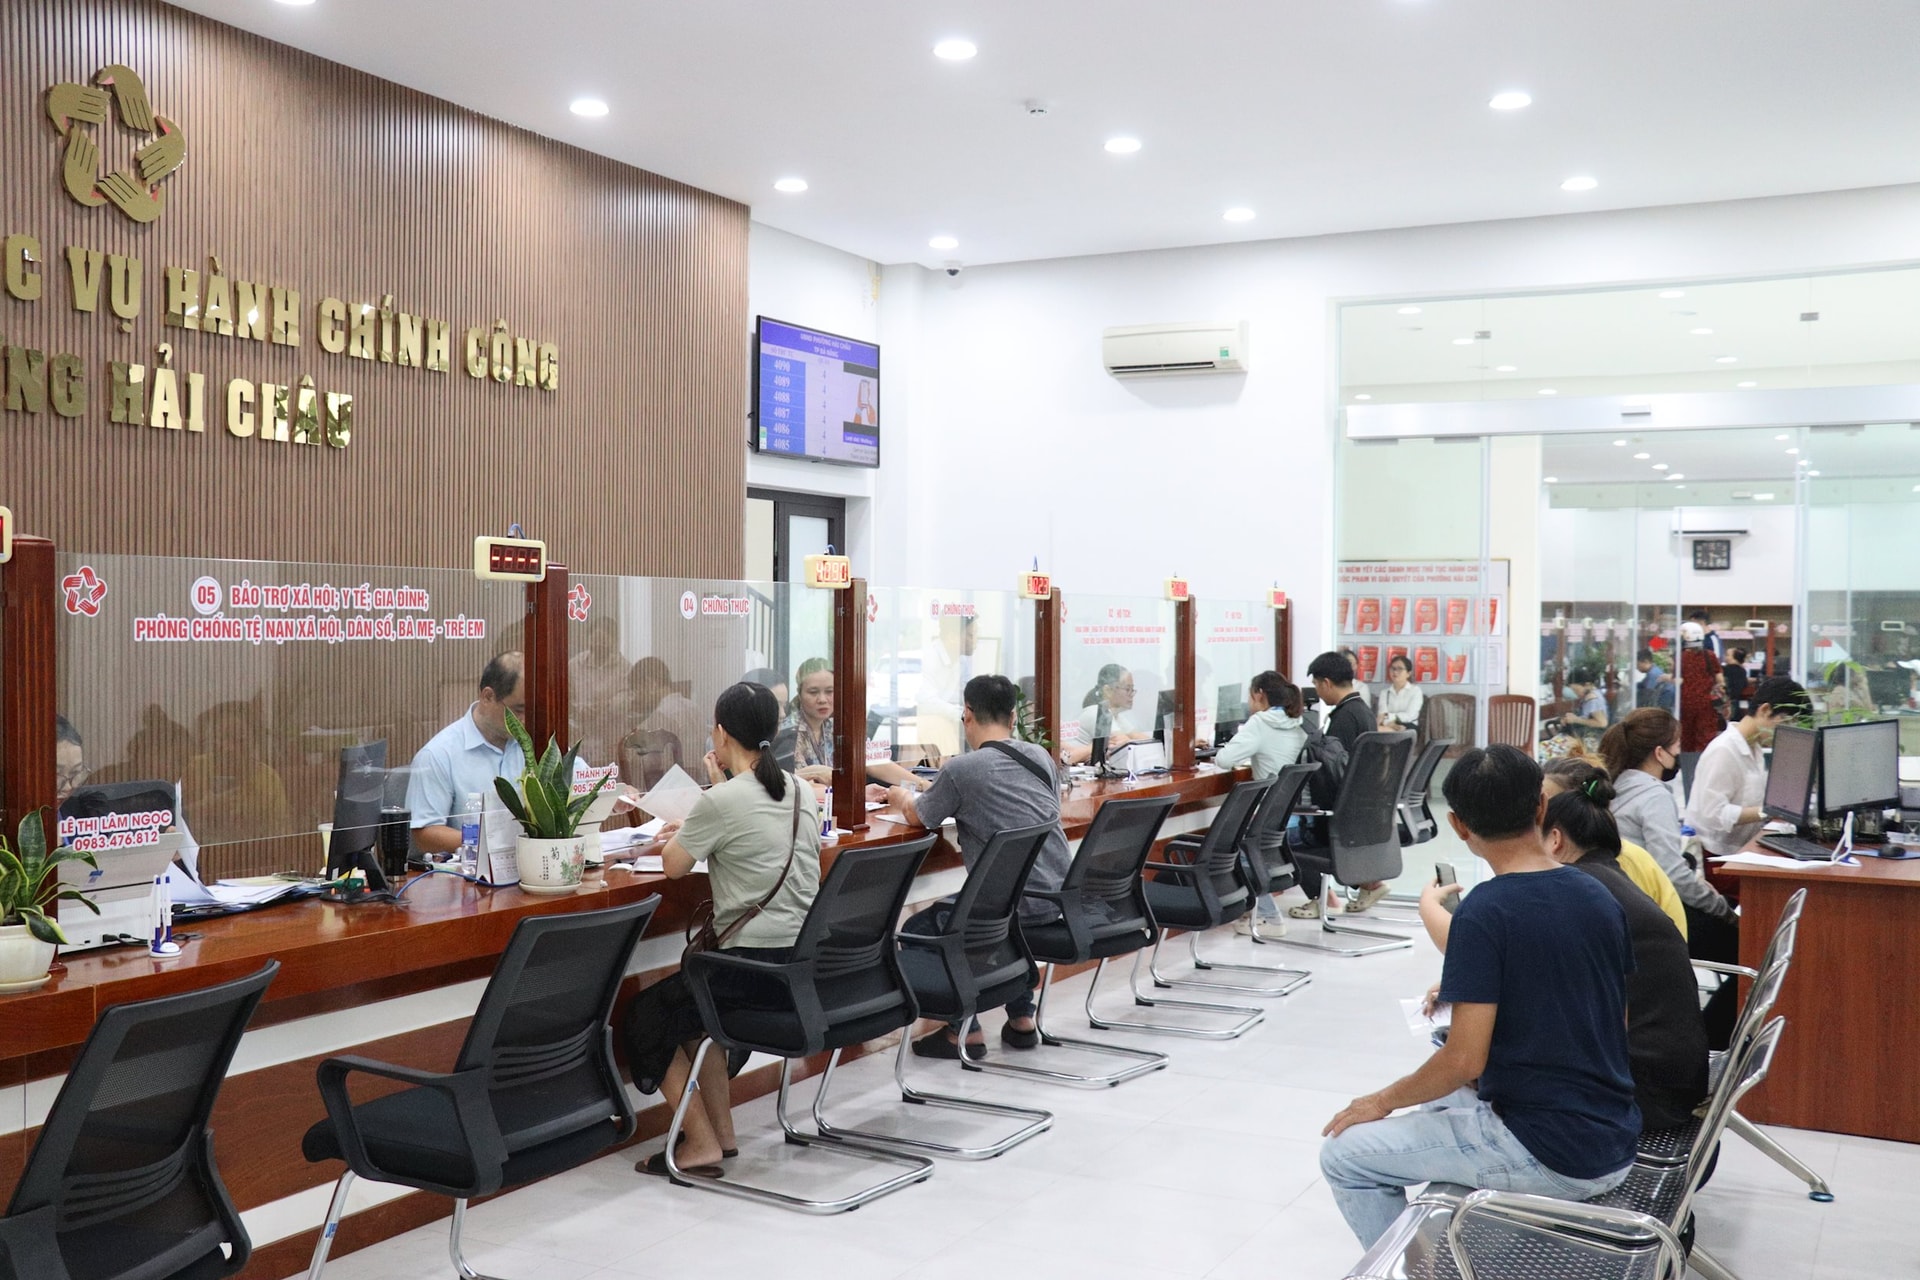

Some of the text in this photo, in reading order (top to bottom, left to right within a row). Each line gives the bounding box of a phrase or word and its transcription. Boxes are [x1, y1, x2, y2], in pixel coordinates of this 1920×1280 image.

[64, 245, 143, 334] VỤ
[163, 255, 300, 347] HÀNH
[318, 294, 450, 373] CHÍNH
[464, 317, 559, 391] CÔNG
[773, 360, 791, 372] 4090
[0, 338, 353, 449] NG HẢI CHÂU
[773, 407, 791, 418] 4087
[197, 581, 428, 611] 05 BẢO TRỢ XÃ HỘI; Y TẾ; GIA ĐÌNH;
[684, 596, 749, 615] 04 CHỨNG THỰC
[136, 615, 188, 639] PHÒNG
[192, 614, 241, 639] CHỐNG
[245, 617, 261, 643] TỆ
[266, 619, 294, 642] NẠN
[298, 617, 316, 638] XÃ
[319, 617, 344, 641] HỘI,
[347, 617, 372, 638] DÂN
[376, 614, 396, 640] SỐ,
[399, 617, 414, 638] BÀ
[417, 620, 435, 641] MẸ
[446, 615, 465, 638] TRẺ
[468, 620, 484, 638] EM
[61, 811, 171, 834] LÊ THỊ LÂM NGỌC
[75, 831, 158, 851] 0983.476.812
